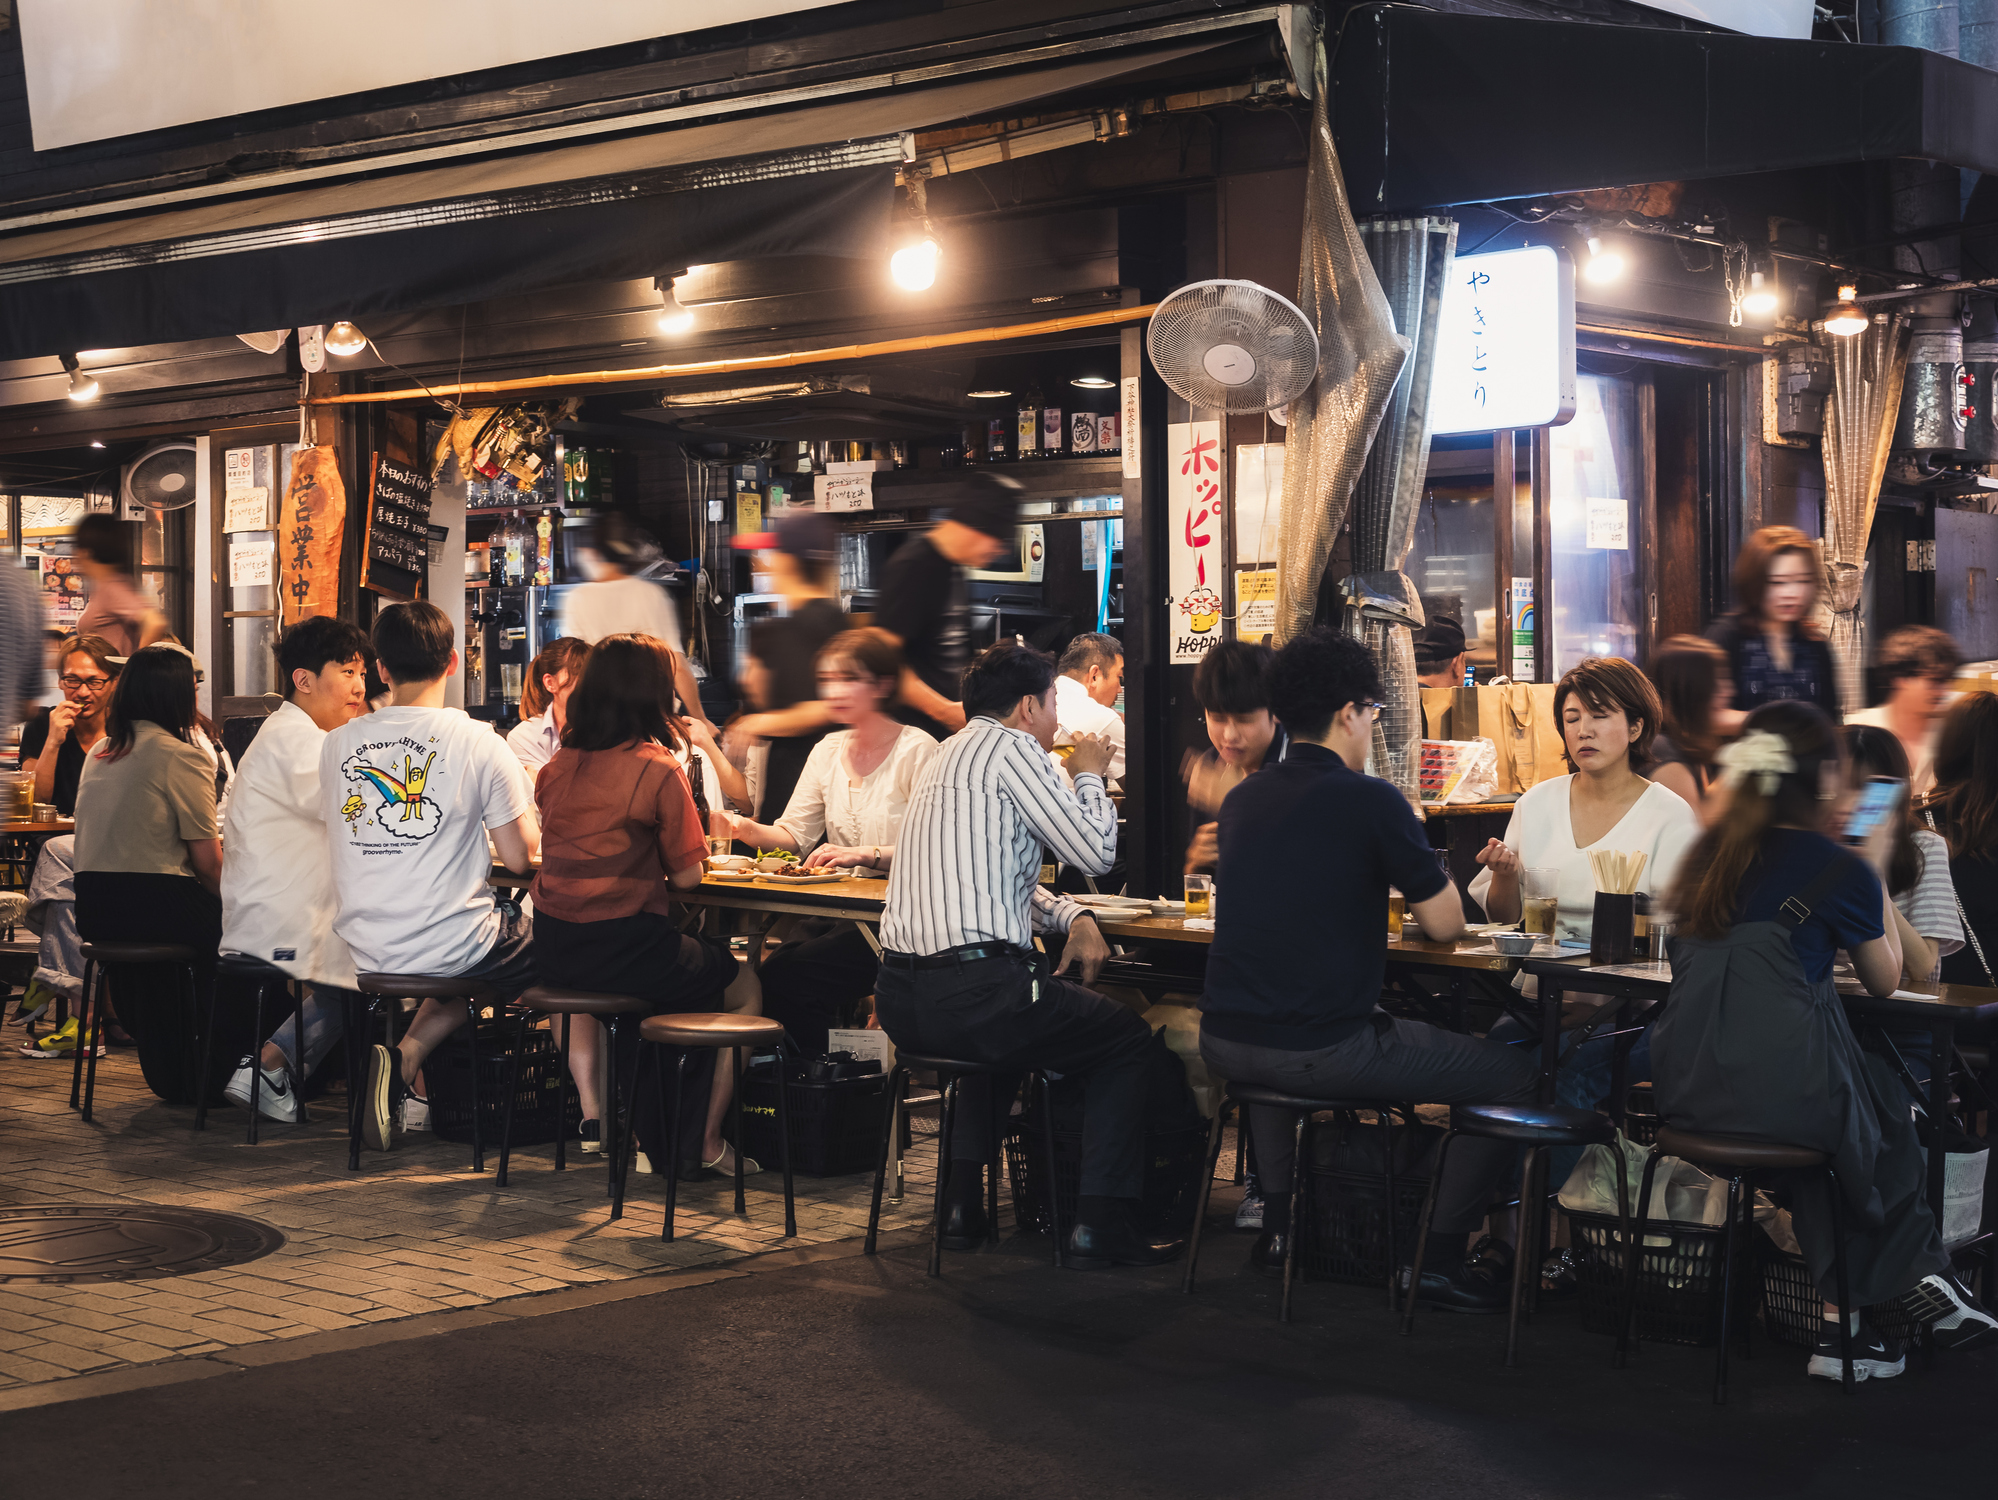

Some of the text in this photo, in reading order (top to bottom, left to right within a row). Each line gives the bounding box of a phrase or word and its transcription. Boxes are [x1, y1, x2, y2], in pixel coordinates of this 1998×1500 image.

[1466, 270, 1491, 409] やきとり
[290, 473, 318, 617] 営業中
[376, 545, 402, 565] アスパラ
[1181, 428, 1222, 587] ホッピー
